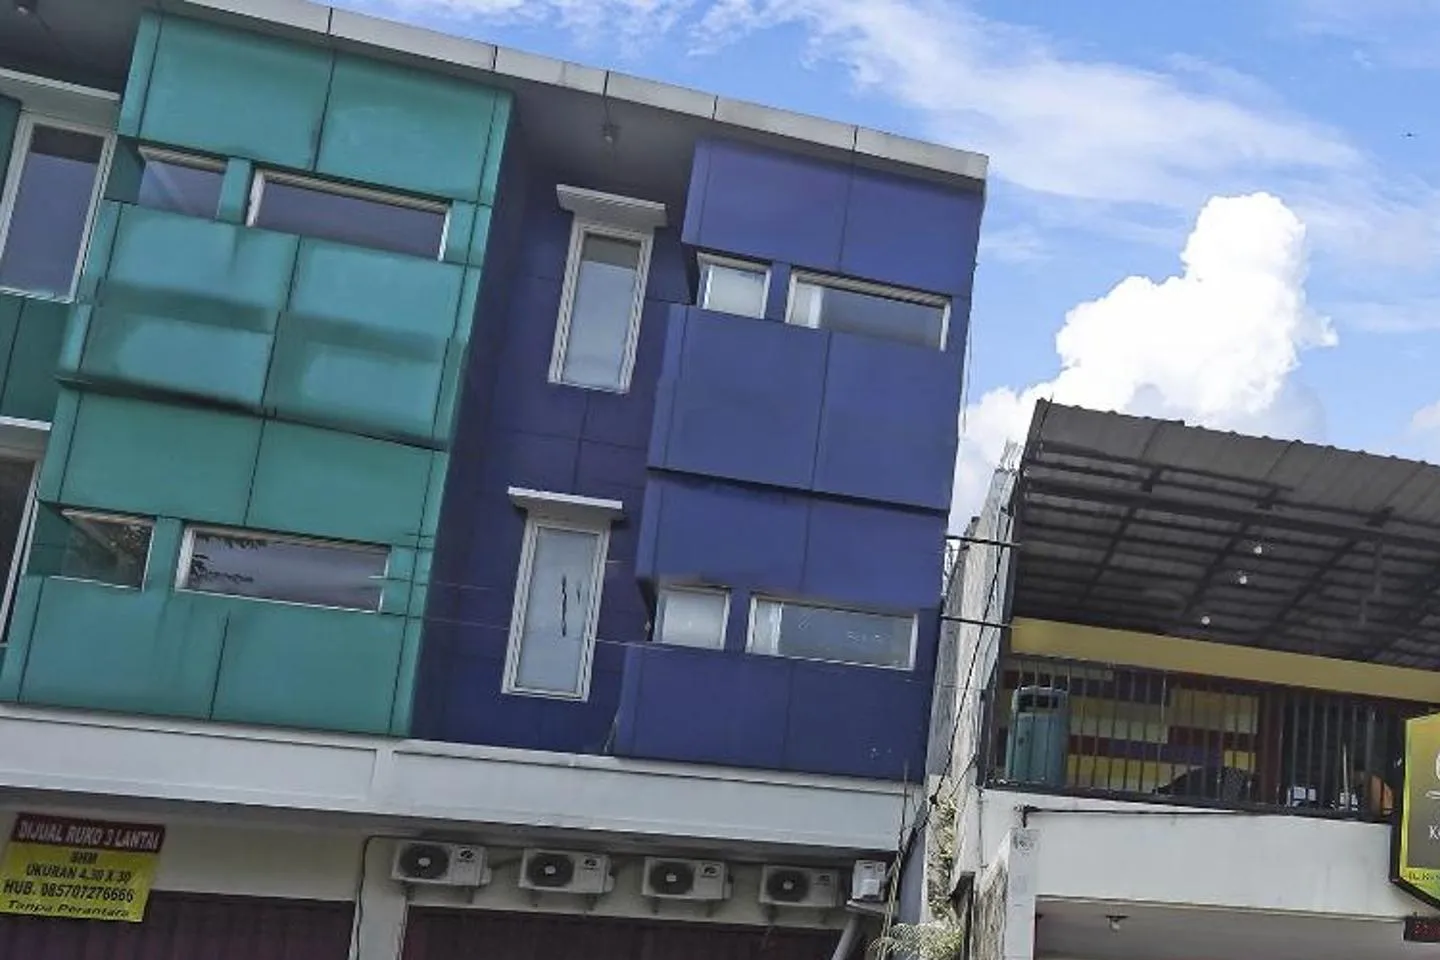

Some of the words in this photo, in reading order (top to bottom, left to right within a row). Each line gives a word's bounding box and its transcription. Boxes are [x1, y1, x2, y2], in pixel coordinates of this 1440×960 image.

[18, 821, 62, 842] DIJUAL
[66, 825, 103, 847] RUKO
[115, 830, 161, 850] LANTAI
[3, 879, 36, 896] HUB.
[8, 900, 53, 913] Tanpa
[57, 904, 130, 917] Perantara
